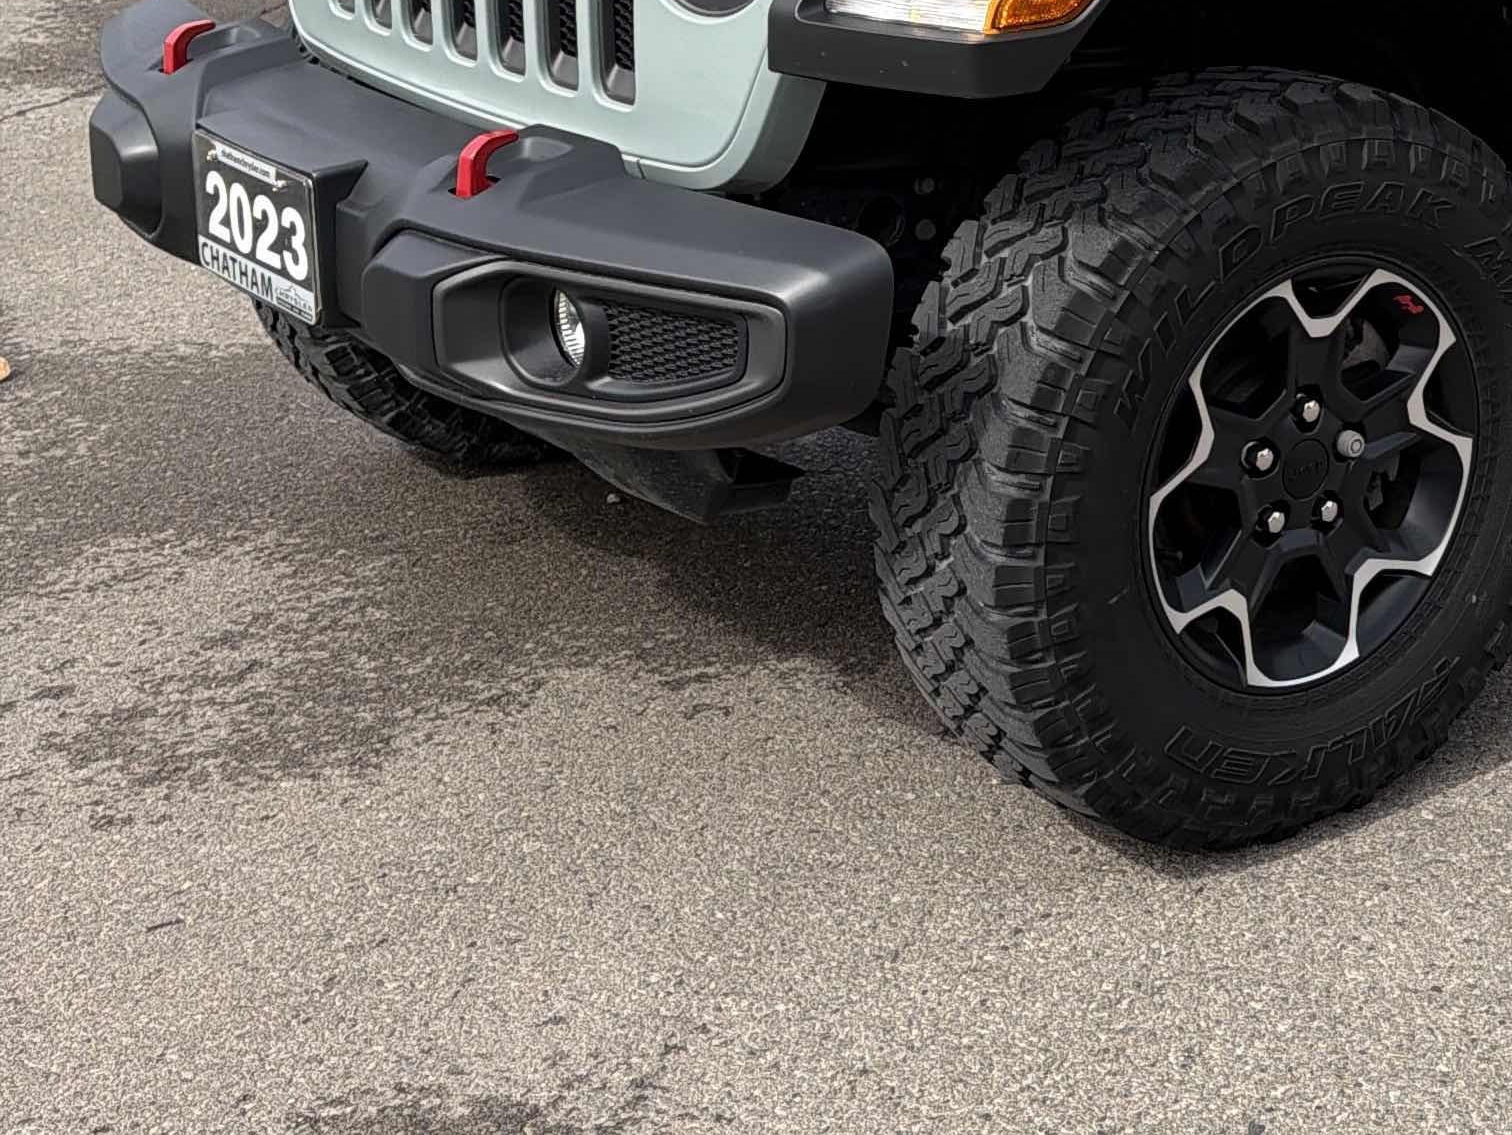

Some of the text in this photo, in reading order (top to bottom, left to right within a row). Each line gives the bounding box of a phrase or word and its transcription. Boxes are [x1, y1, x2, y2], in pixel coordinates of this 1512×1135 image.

[201, 242, 274, 302] CHATHAM
[205, 170, 309, 281] 2023
[1113, 180, 1454, 428] WILDPEAK
[1164, 655, 1461, 787] FALKEN
